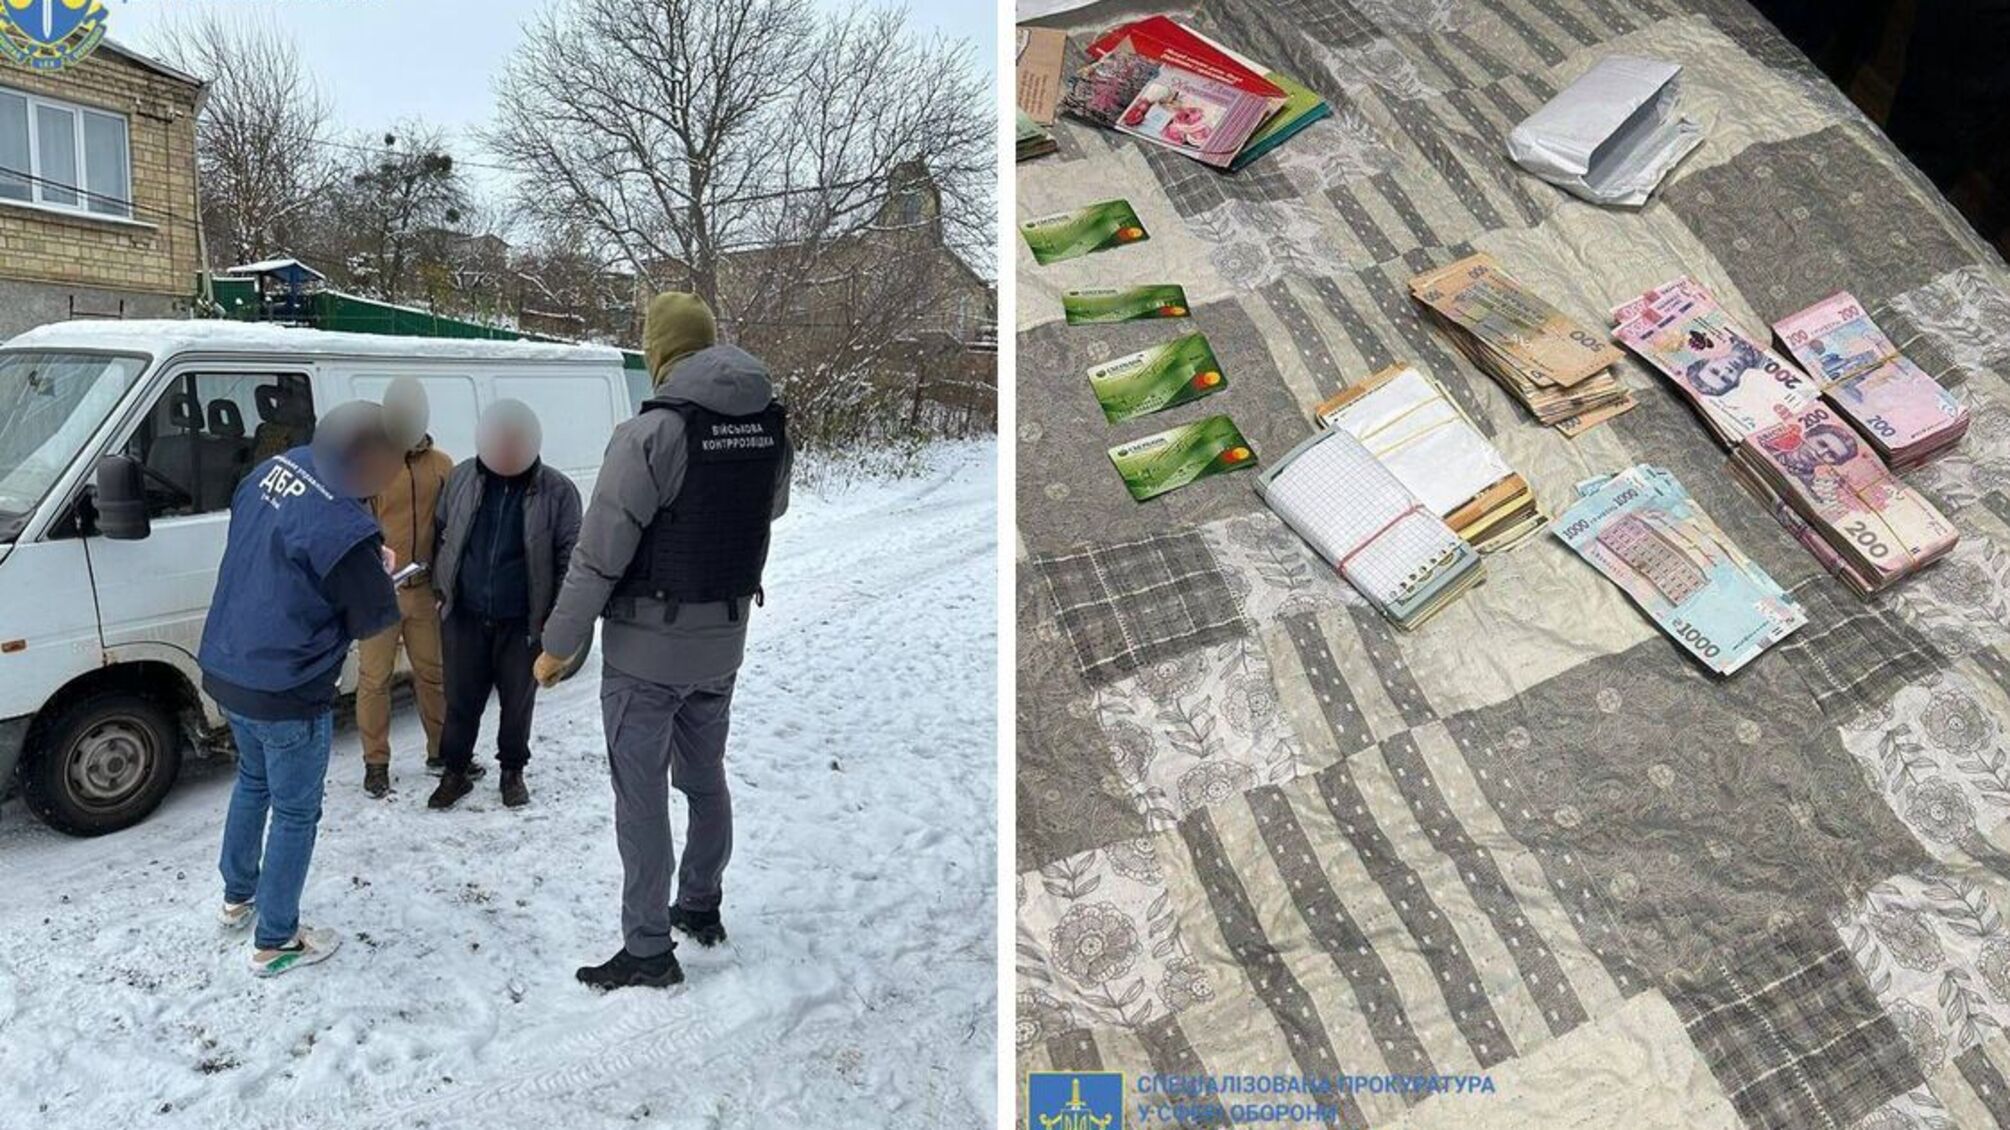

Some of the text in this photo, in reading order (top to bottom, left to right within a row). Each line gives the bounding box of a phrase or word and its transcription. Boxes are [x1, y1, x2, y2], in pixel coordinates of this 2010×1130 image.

[1569, 330, 1606, 353] 500
[1786, 329, 1809, 347] 200
[1838, 305, 1859, 321] 200
[1764, 361, 1803, 390] 200
[1798, 408, 1829, 429] 200
[1866, 414, 1896, 437] 200
[259, 464, 306, 498] ДБР
[1562, 519, 1589, 540] 1000
[1613, 488, 1639, 507] 1000
[1843, 520, 1889, 559] 200
